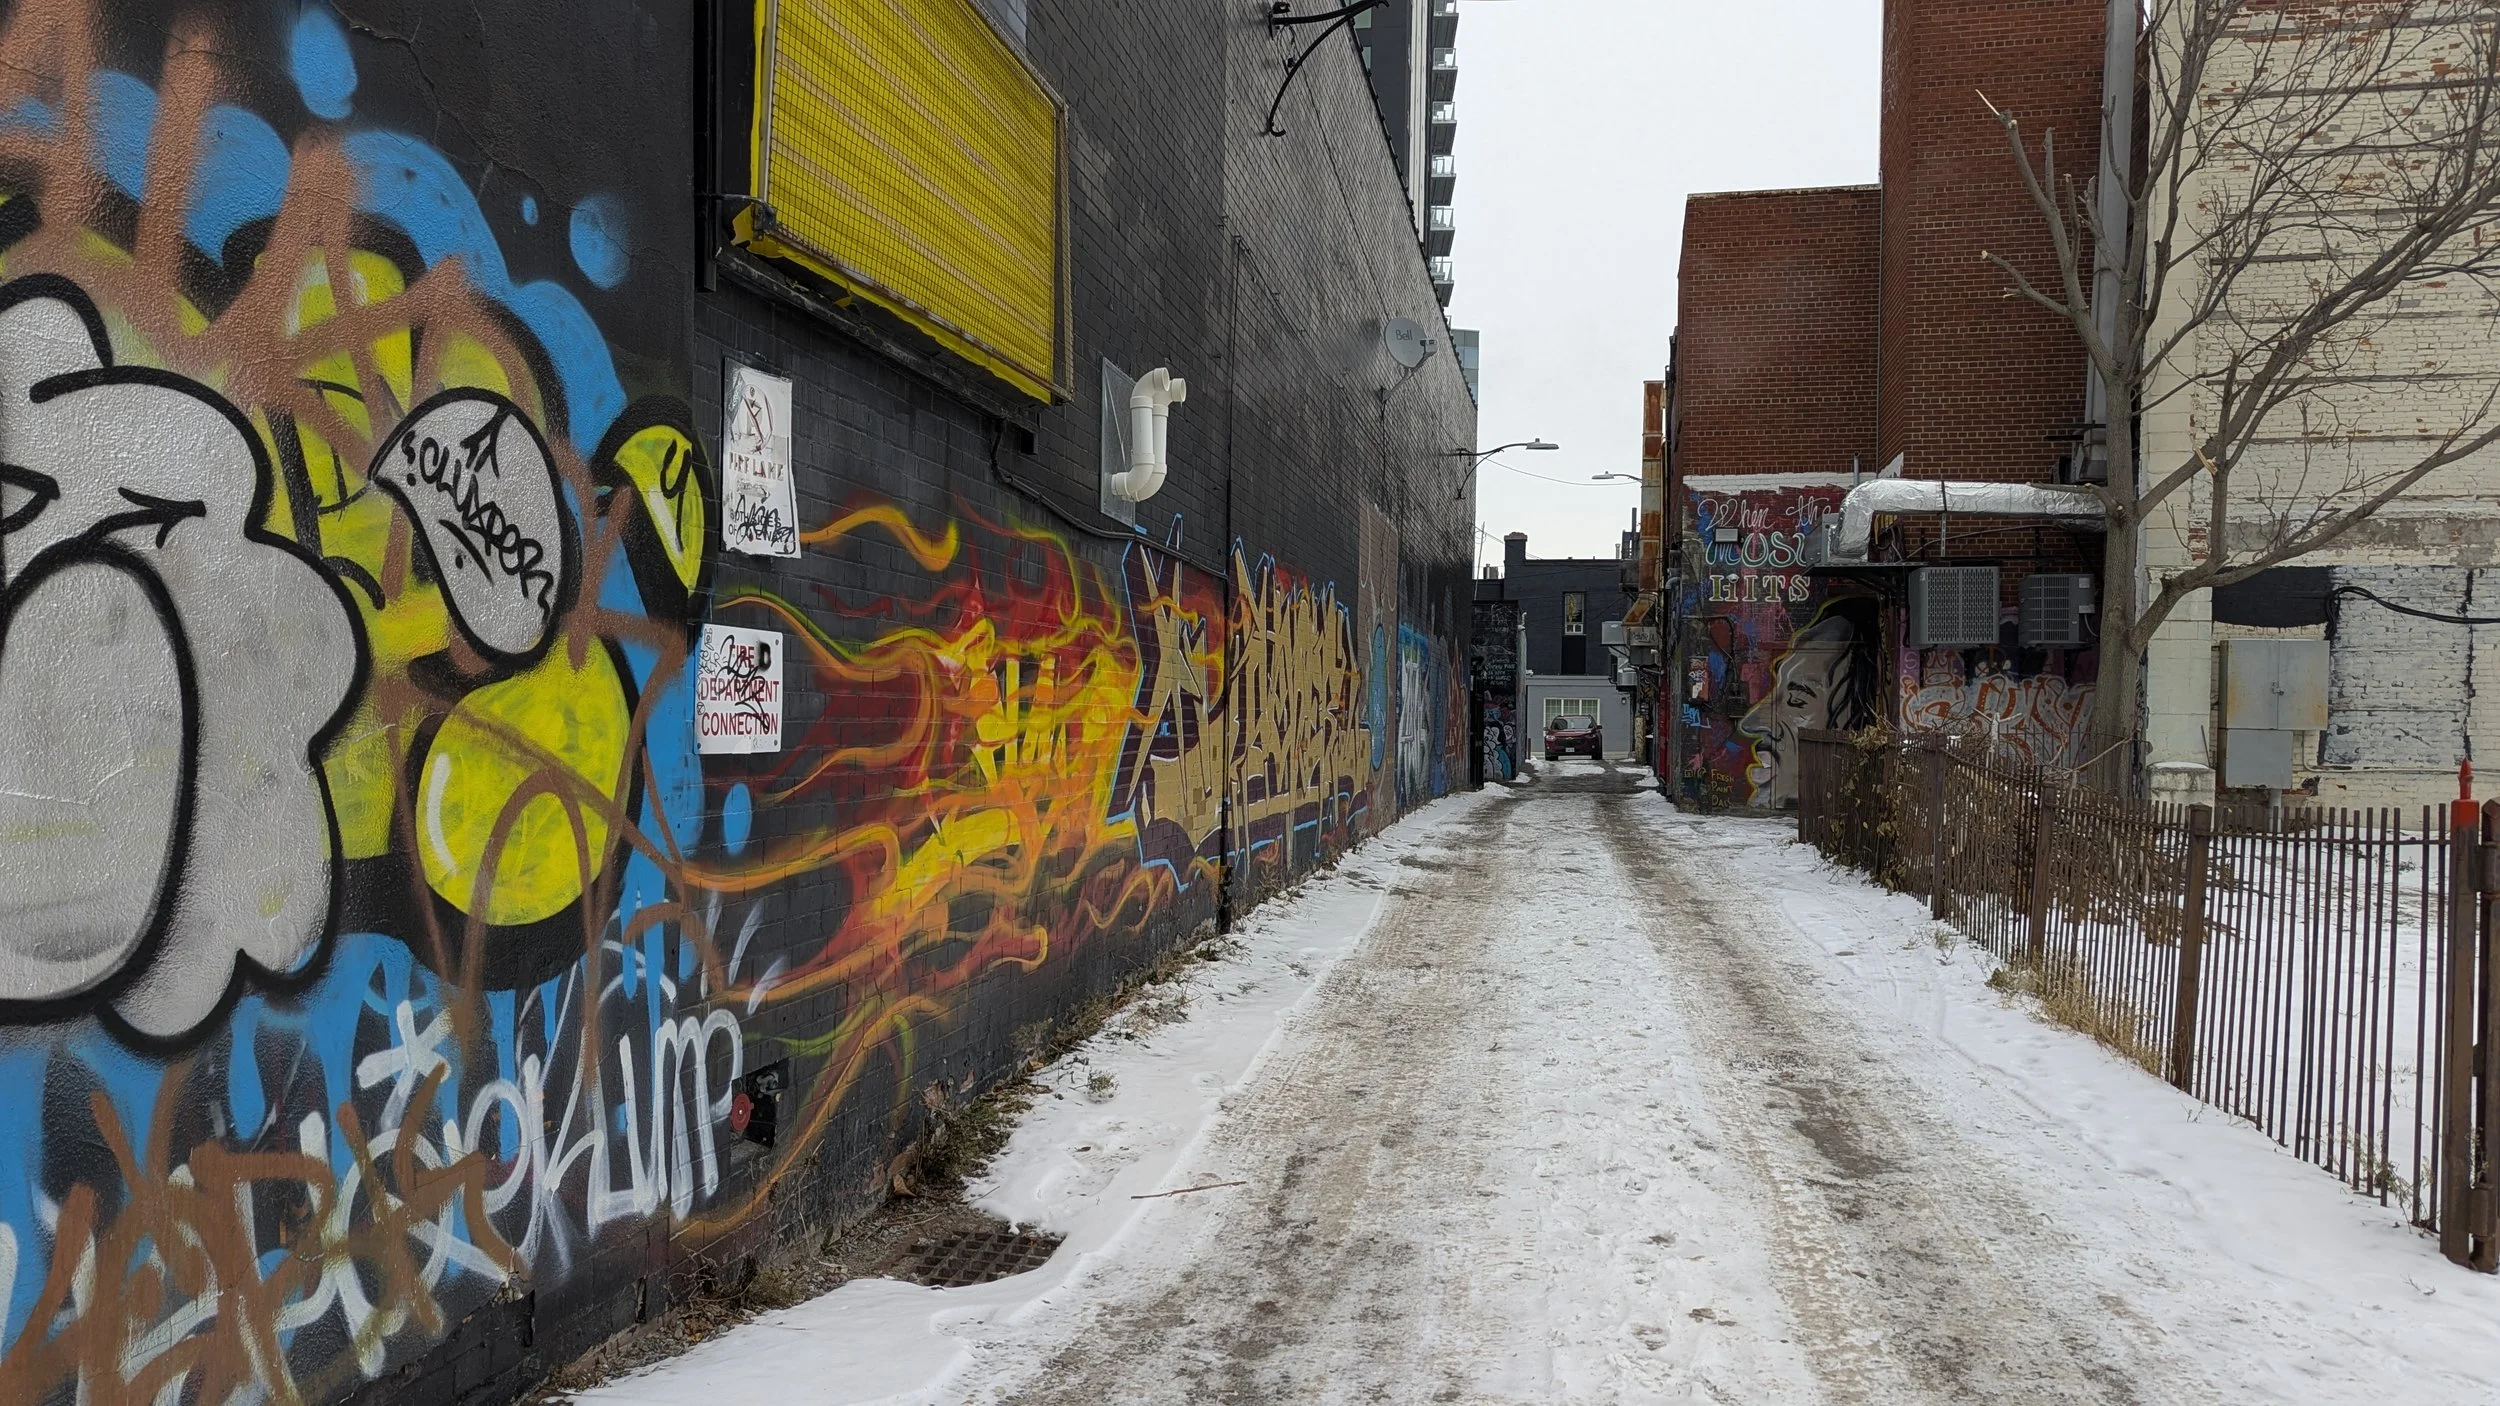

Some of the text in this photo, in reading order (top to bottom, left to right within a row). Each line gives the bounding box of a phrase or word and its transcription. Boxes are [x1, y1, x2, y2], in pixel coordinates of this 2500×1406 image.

[1396, 329, 1414, 341] Bell
[1697, 498, 1776, 531] When
[1708, 574, 1811, 602] HITS
[729, 644, 755, 668] FIRE
[700, 677, 780, 703] DEPARTMENT
[701, 711, 779, 736] CONNECTION
